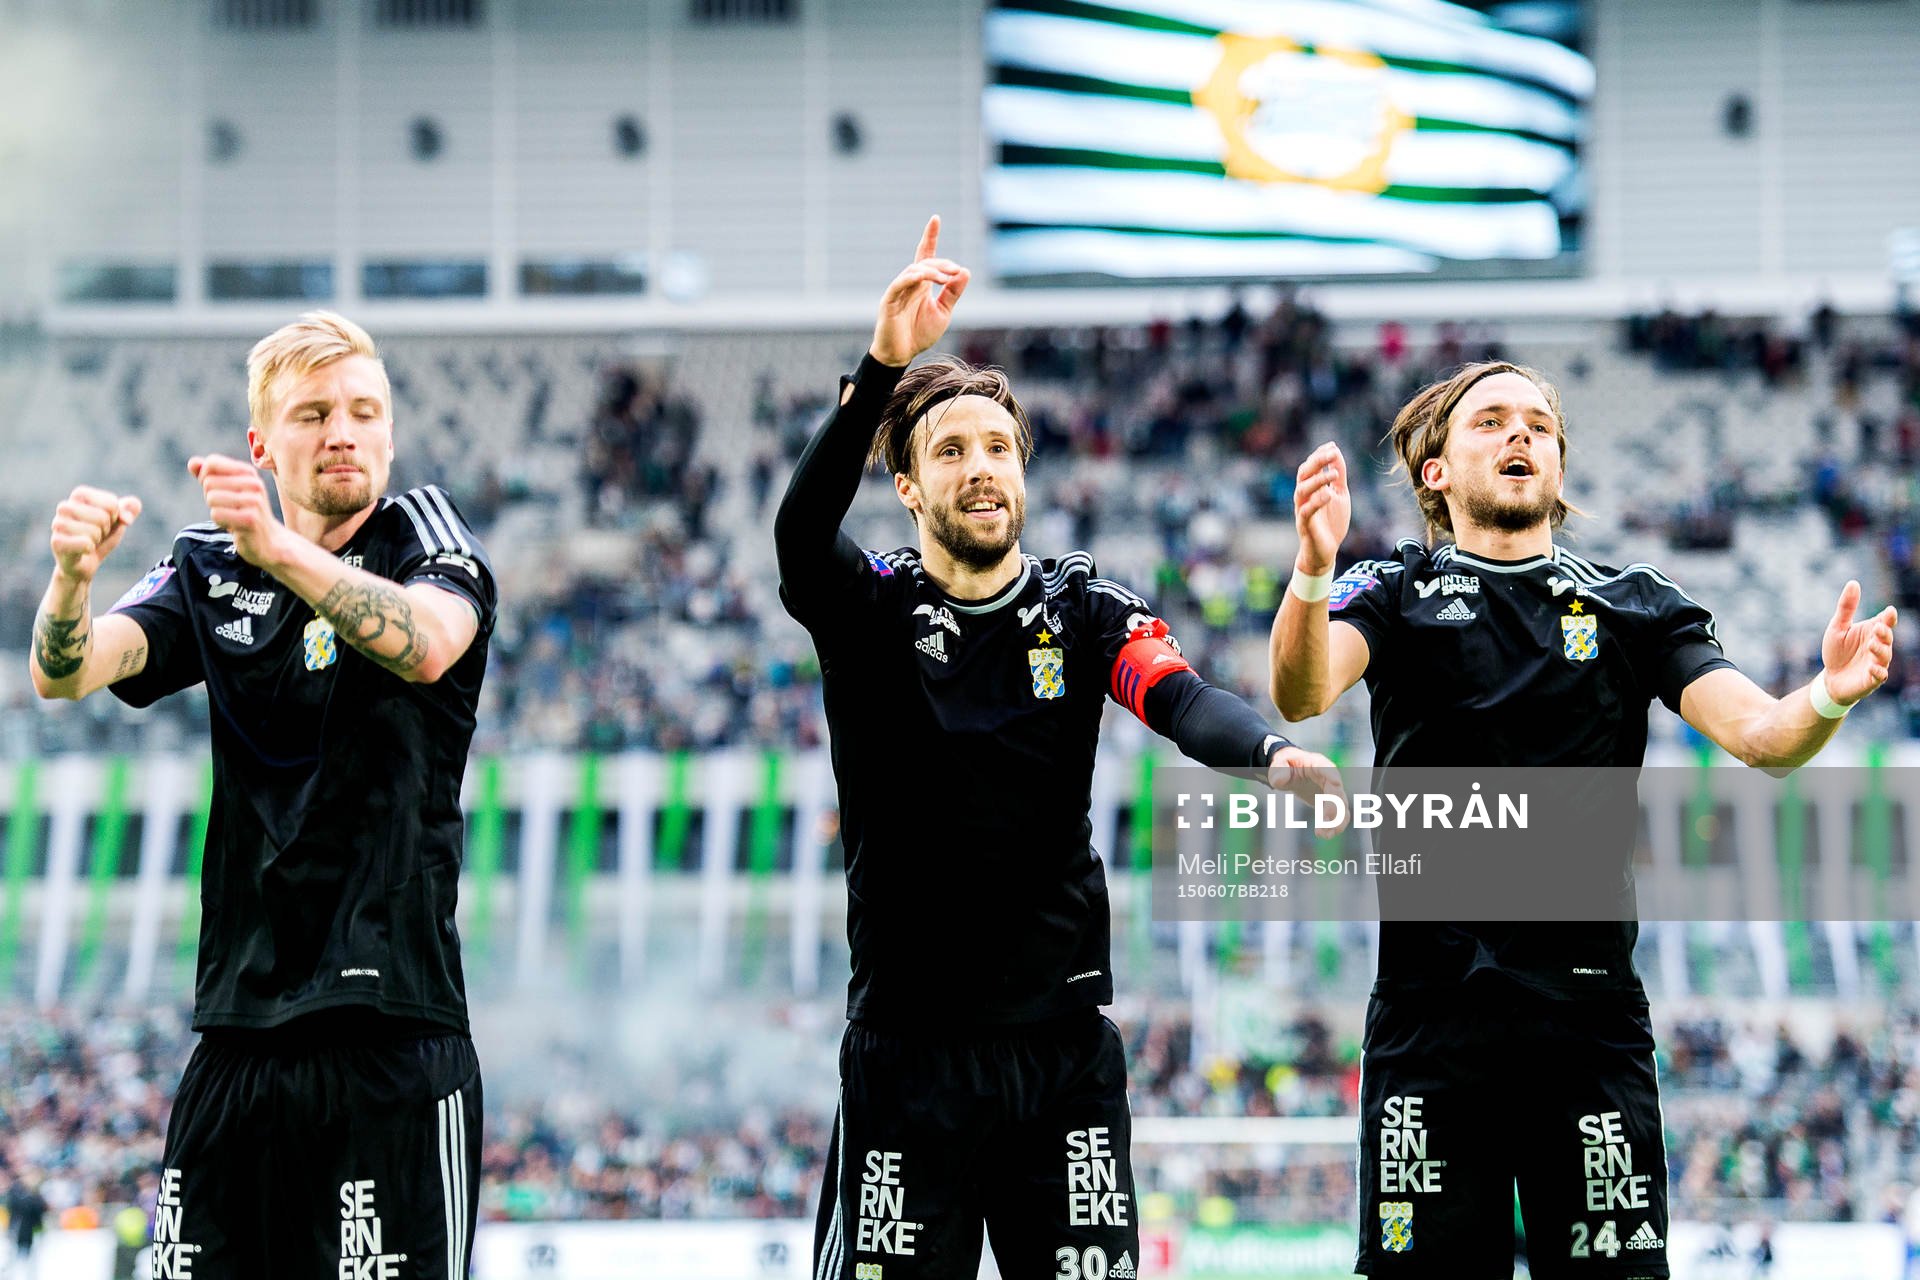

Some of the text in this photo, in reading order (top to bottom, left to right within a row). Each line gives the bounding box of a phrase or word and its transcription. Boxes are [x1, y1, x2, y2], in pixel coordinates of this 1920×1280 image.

[237, 587, 276, 605] INTER
[1441, 575, 1479, 586] INTER
[1441, 584, 1480, 596] SPORT
[232, 597, 271, 616] SPORT
[1436, 612, 1477, 620] adidas
[215, 626, 254, 645] adidas
[915, 640, 948, 663] adidas
[1381, 1096, 1423, 1129] SE
[1578, 1111, 1625, 1146] SE
[1066, 1127, 1111, 1161] SE
[1380, 1128, 1427, 1160] RN
[1584, 1143, 1633, 1178] RN
[862, 1150, 902, 1185] SE
[1067, 1158, 1117, 1192] RN
[1379, 1160, 1442, 1193] EKE
[340, 1179, 375, 1219] SE
[859, 1183, 904, 1220] RN
[1068, 1192, 1129, 1226] EKE
[1586, 1175, 1649, 1211] EKE
[153, 1205, 183, 1242] RN
[341, 1216, 382, 1257] RN
[856, 1217, 917, 1256] EKE
[1570, 1220, 1664, 1258] 24 adidas
[1055, 1245, 1108, 1280] 30
